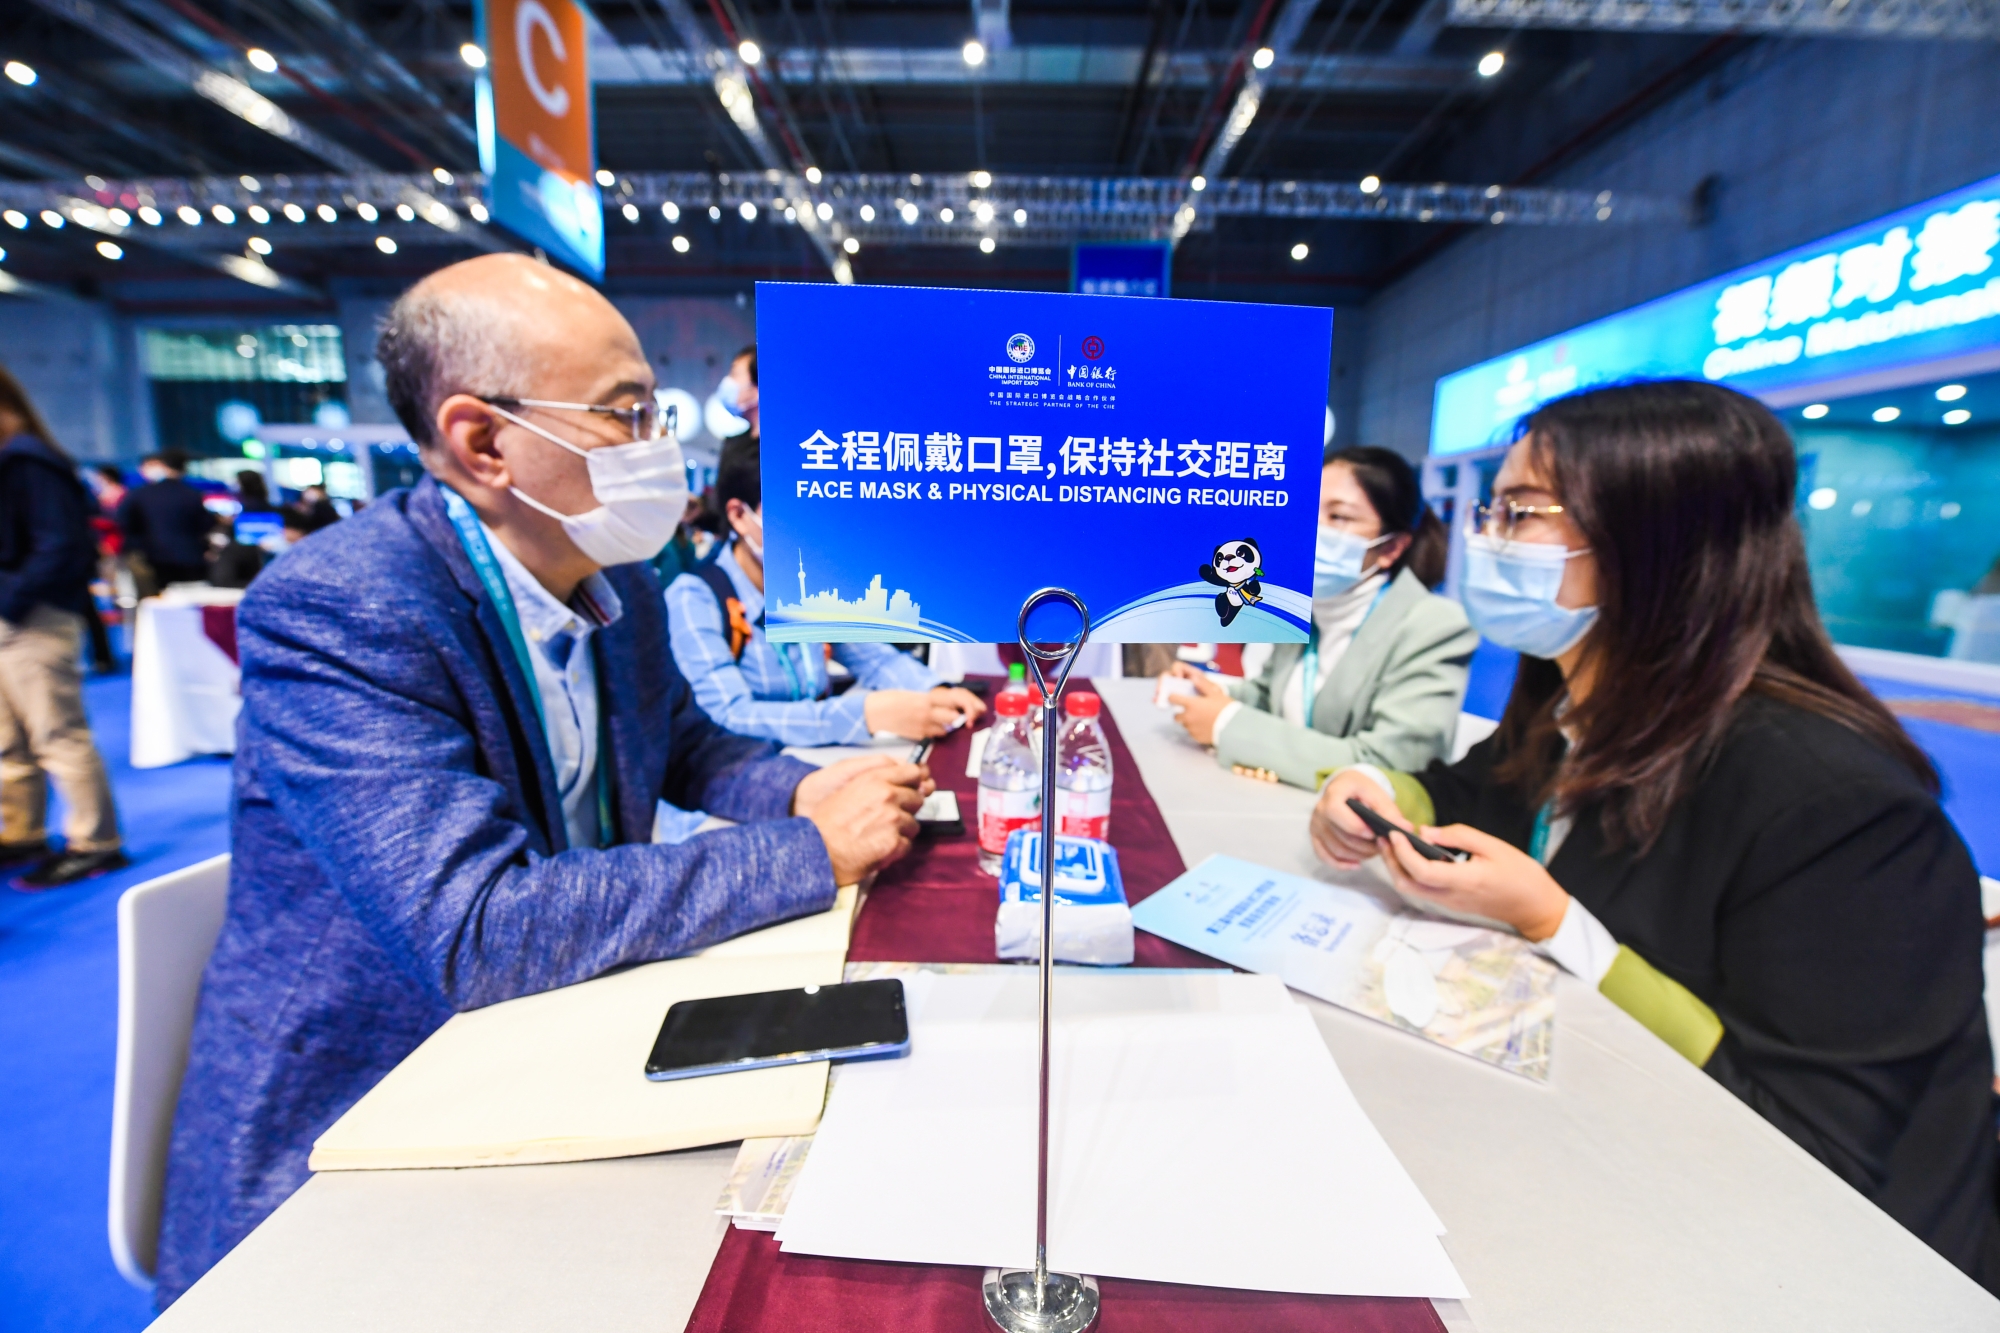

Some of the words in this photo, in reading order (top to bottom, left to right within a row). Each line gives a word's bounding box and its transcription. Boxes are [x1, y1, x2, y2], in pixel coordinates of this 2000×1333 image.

[514, 0, 570, 118] C
[1067, 365, 1117, 381] 中国银行
[796, 480, 852, 499] FACE
[859, 481, 921, 500] MASK
[928, 482, 943, 500] &
[949, 483, 1053, 502] PHYSICAL
[1059, 485, 1182, 505] DISTANCING
[1187, 488, 1289, 508] REQUIRED
